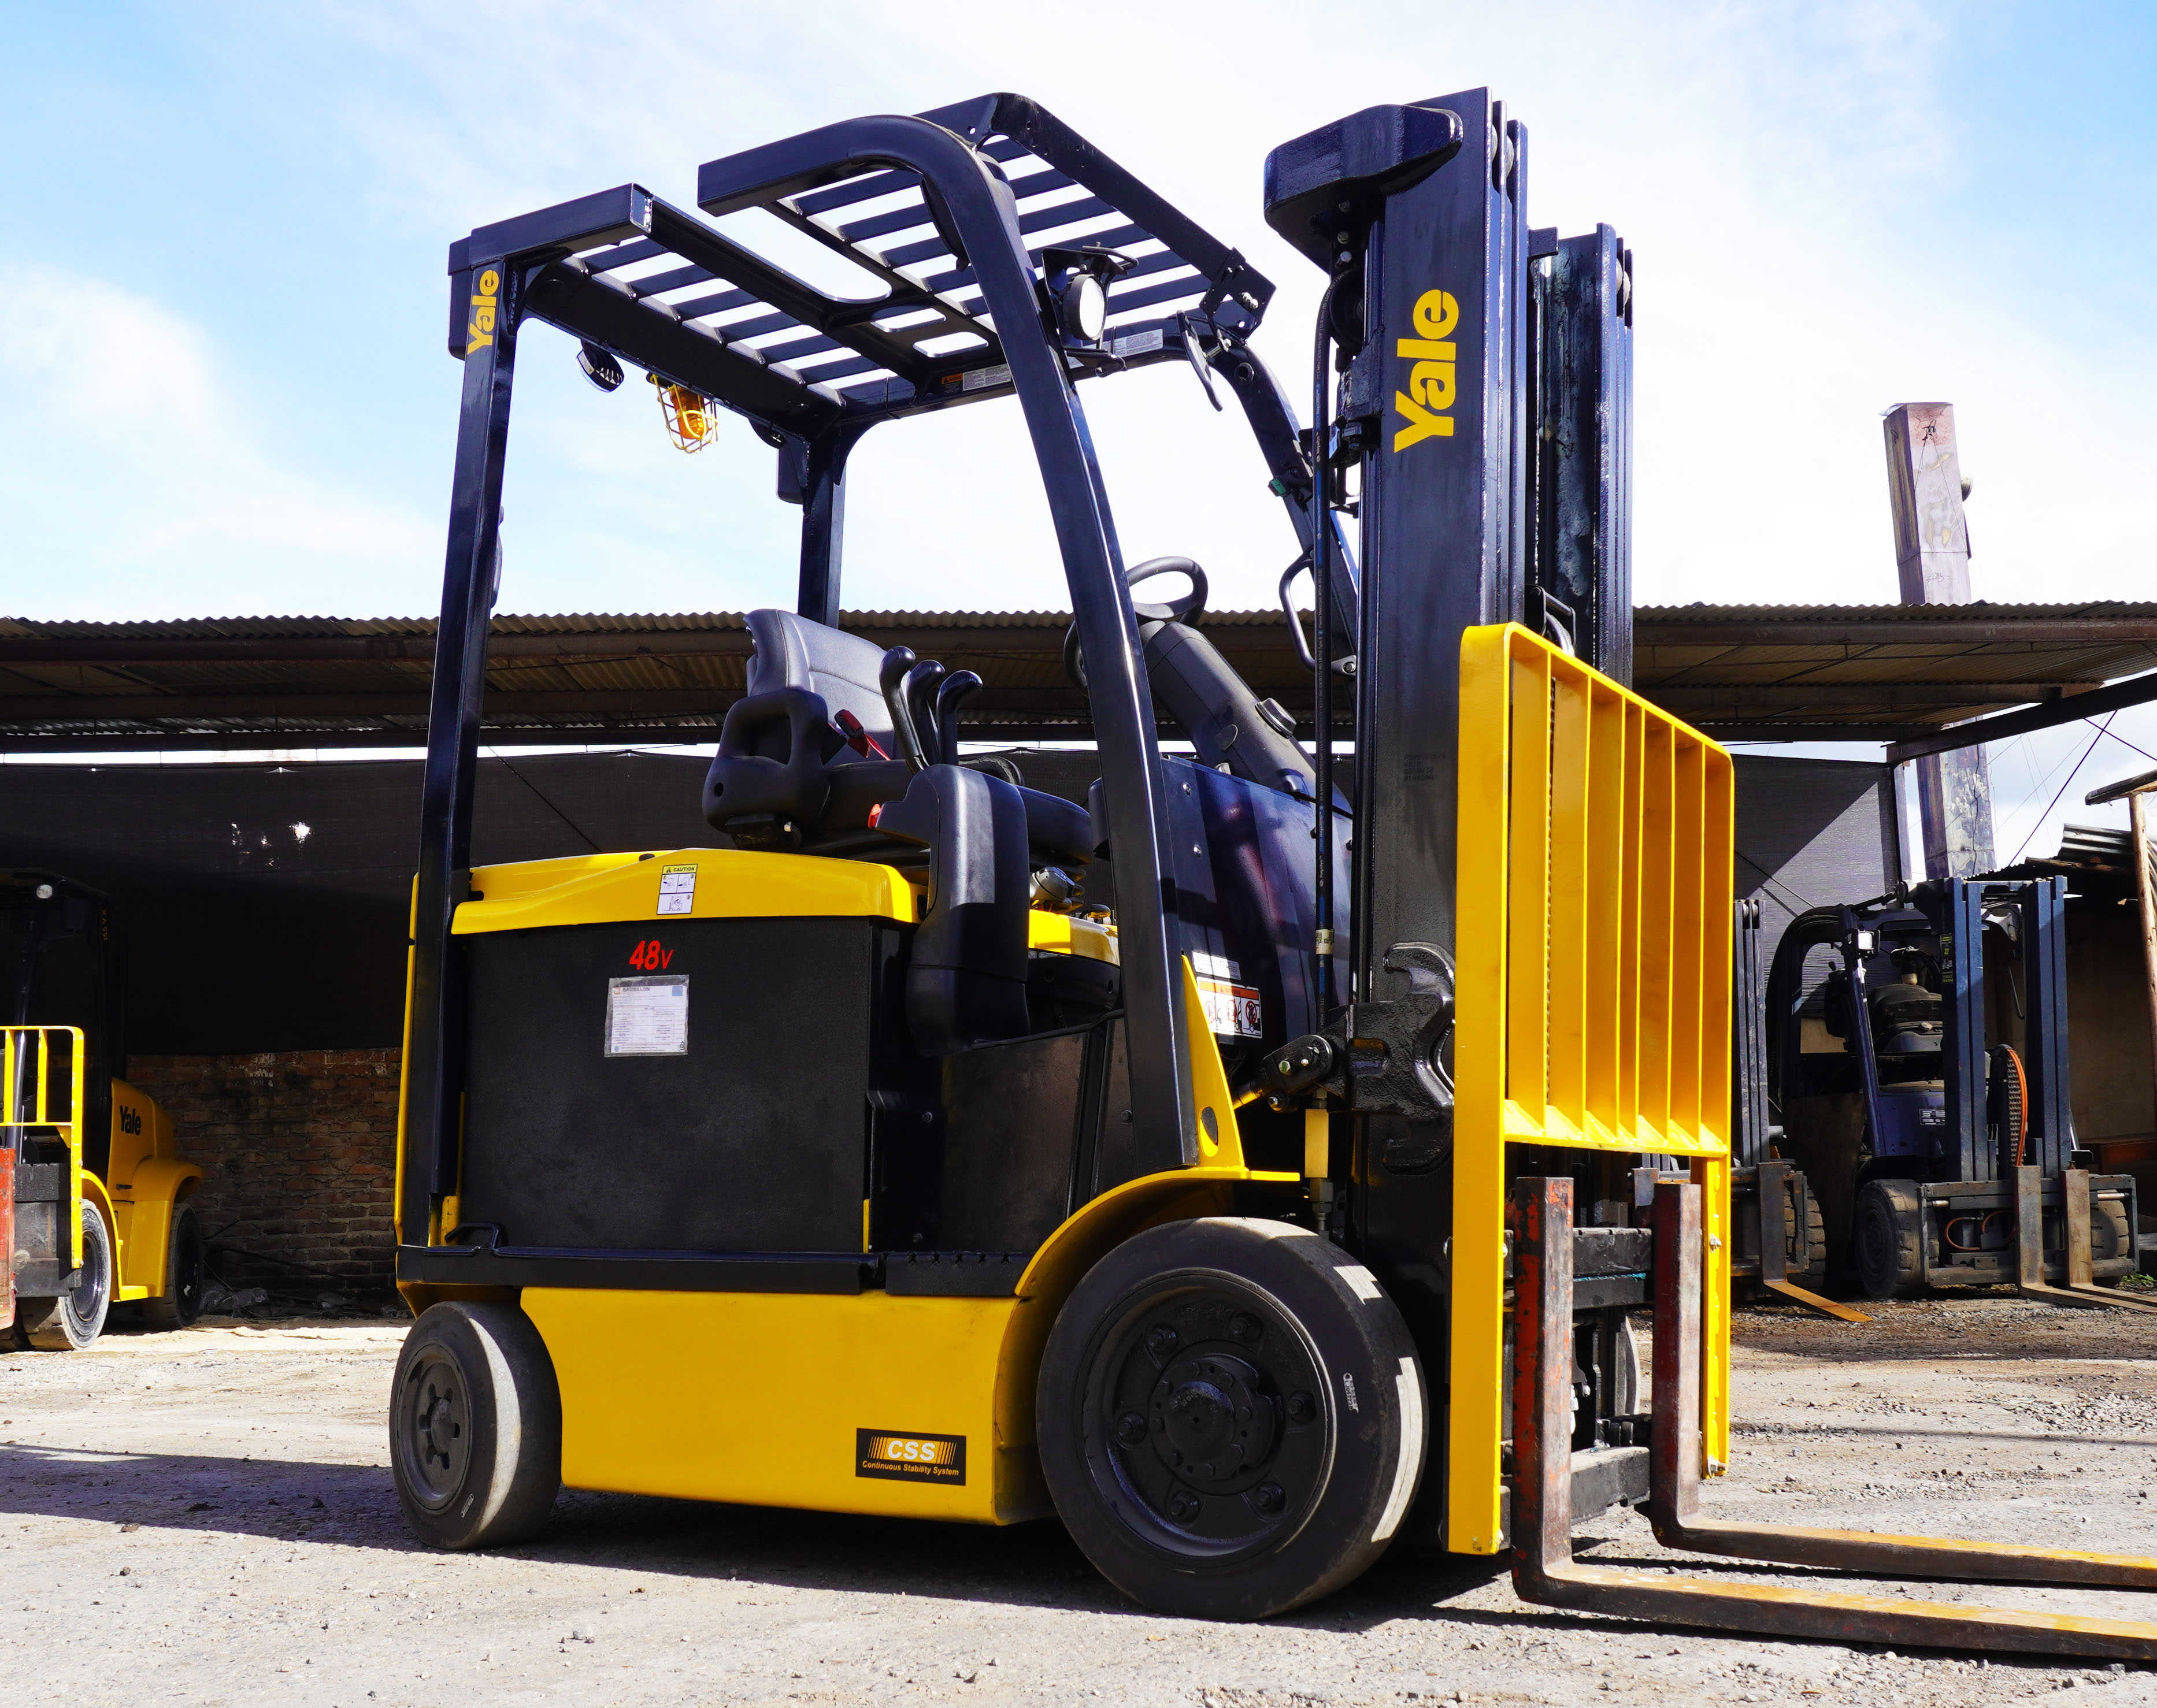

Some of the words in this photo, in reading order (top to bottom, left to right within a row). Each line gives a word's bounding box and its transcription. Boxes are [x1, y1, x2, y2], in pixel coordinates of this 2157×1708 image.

[467, 270, 499, 355] Yale
[1394, 289, 1459, 453] Yale
[120, 1105, 142, 1136] Yale
[888, 1440, 935, 1461] CSS
[862, 1460, 901, 1471] Continuous
[903, 1464, 932, 1475] Stability
[933, 1466, 959, 1476] System
